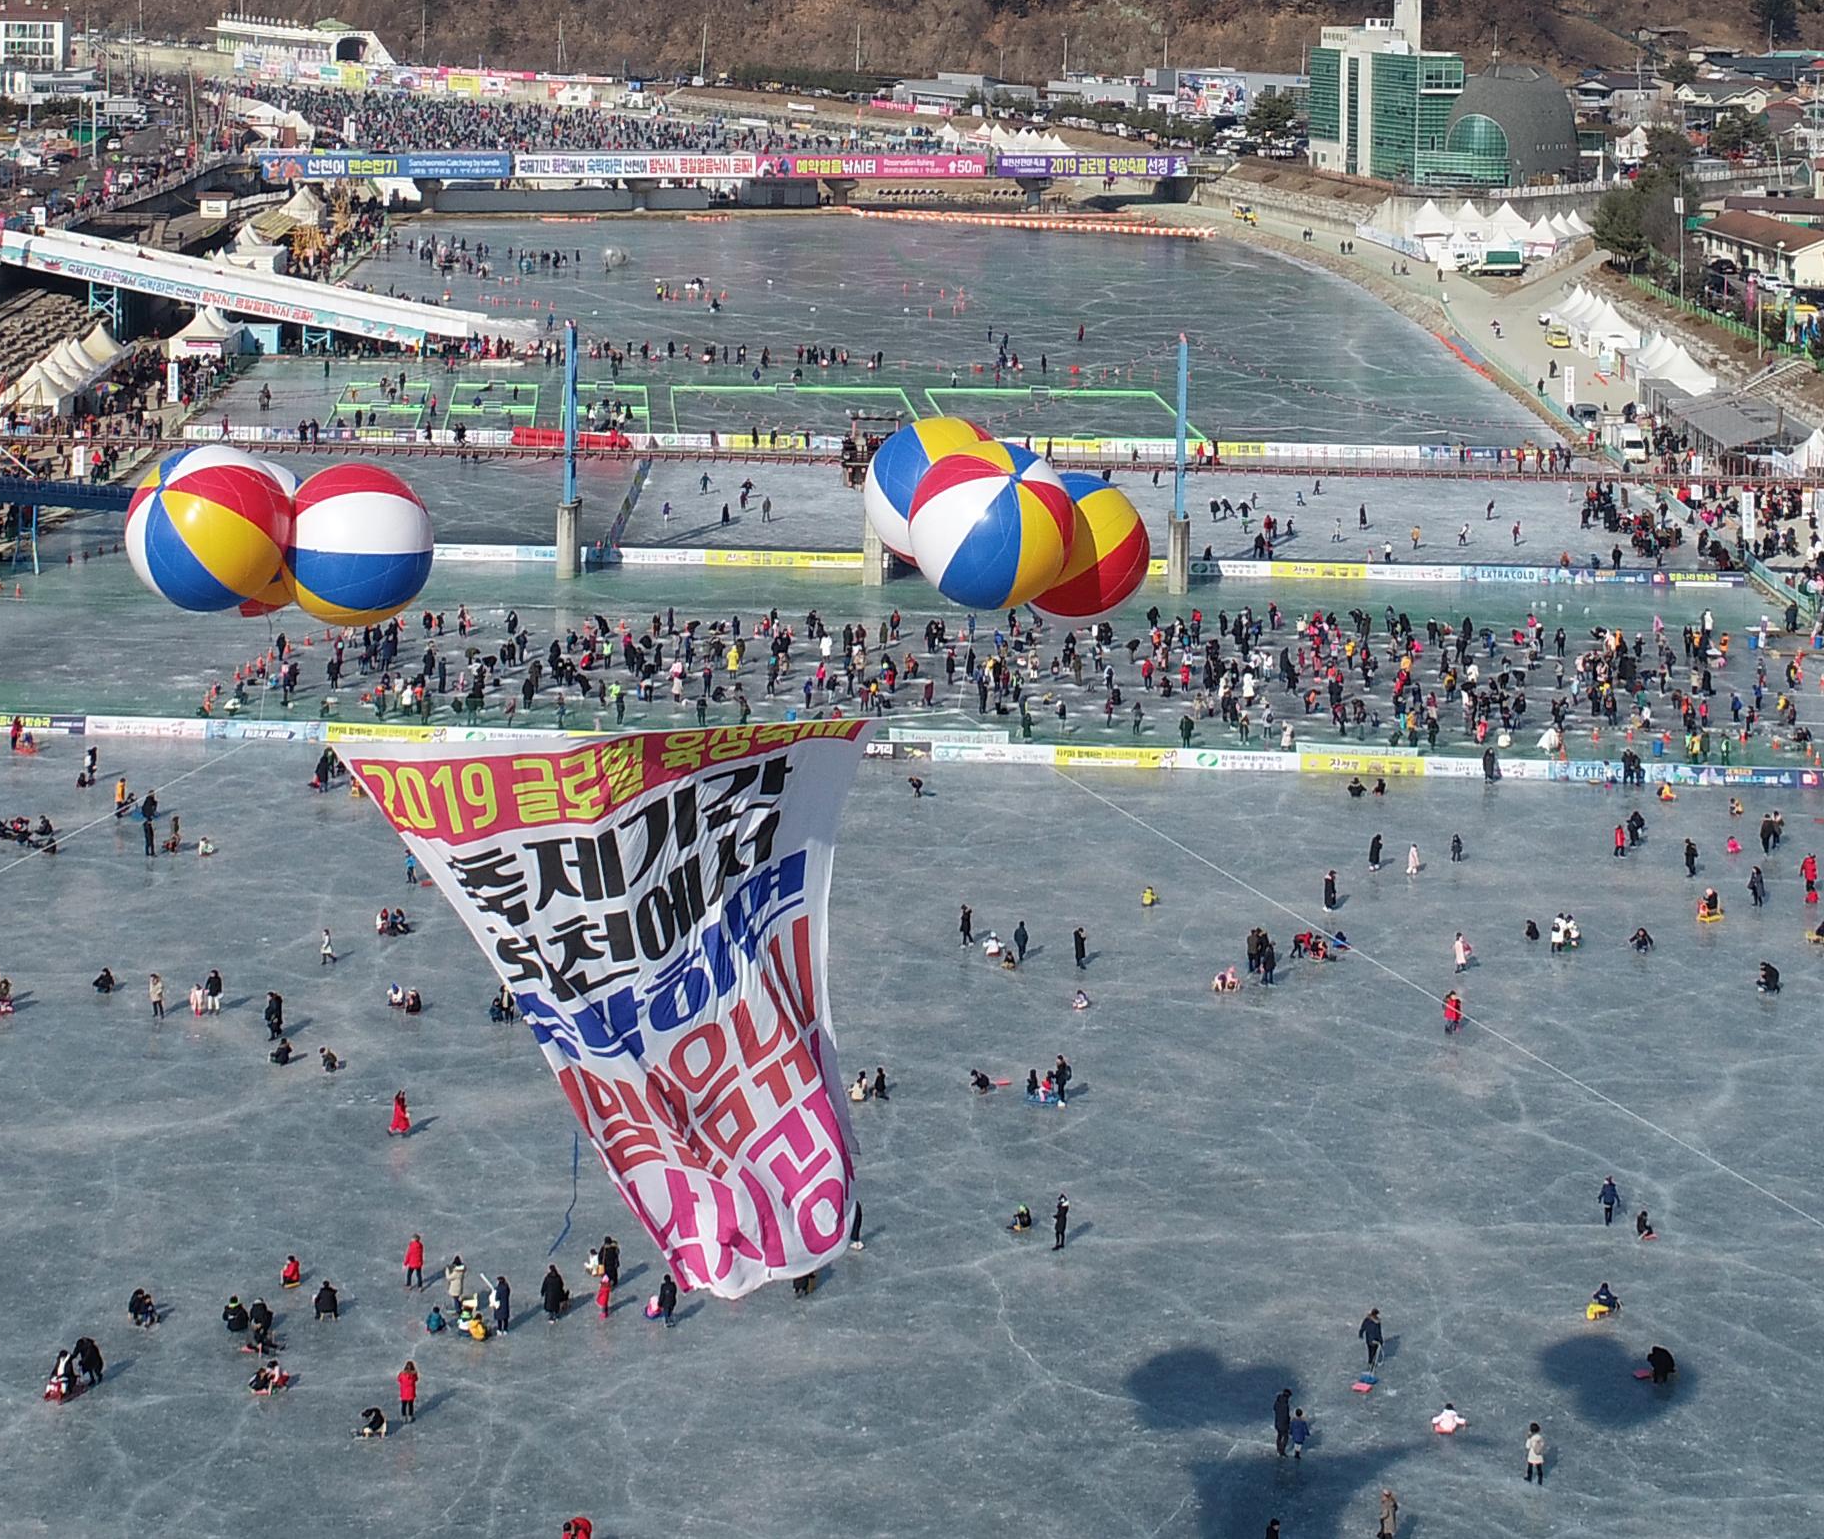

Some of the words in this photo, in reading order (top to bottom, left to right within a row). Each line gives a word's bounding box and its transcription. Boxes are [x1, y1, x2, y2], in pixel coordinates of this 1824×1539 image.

[307, 159, 345, 175] 산천어
[348, 159, 398, 175] 맨손잡기
[519, 159, 550, 174] 축제기간
[552, 158, 585, 174] 화천에서
[587, 158, 623, 174] 숙박하면
[625, 159, 648, 173] 산천어
[680, 158, 731, 174] 평일얼음낚시
[957, 159, 982, 173] 50m
[1050, 158, 1076, 174] 2019
[1079, 158, 1106, 174] 글로벌
[1109, 158, 1146, 174] 육성축제
[1148, 158, 1168, 174] 선정
[67, 262, 100, 280] 축제기간
[101, 269, 137, 287] 화천에서
[137, 278, 175, 295] 숙박하면
[175, 285, 201, 303] 산천어
[1481, 570, 1509, 580] EXTRA
[1511, 571, 1535, 581] COLD
[362, 763, 497, 835] 2019
[512, 737, 645, 823] 글로벌
